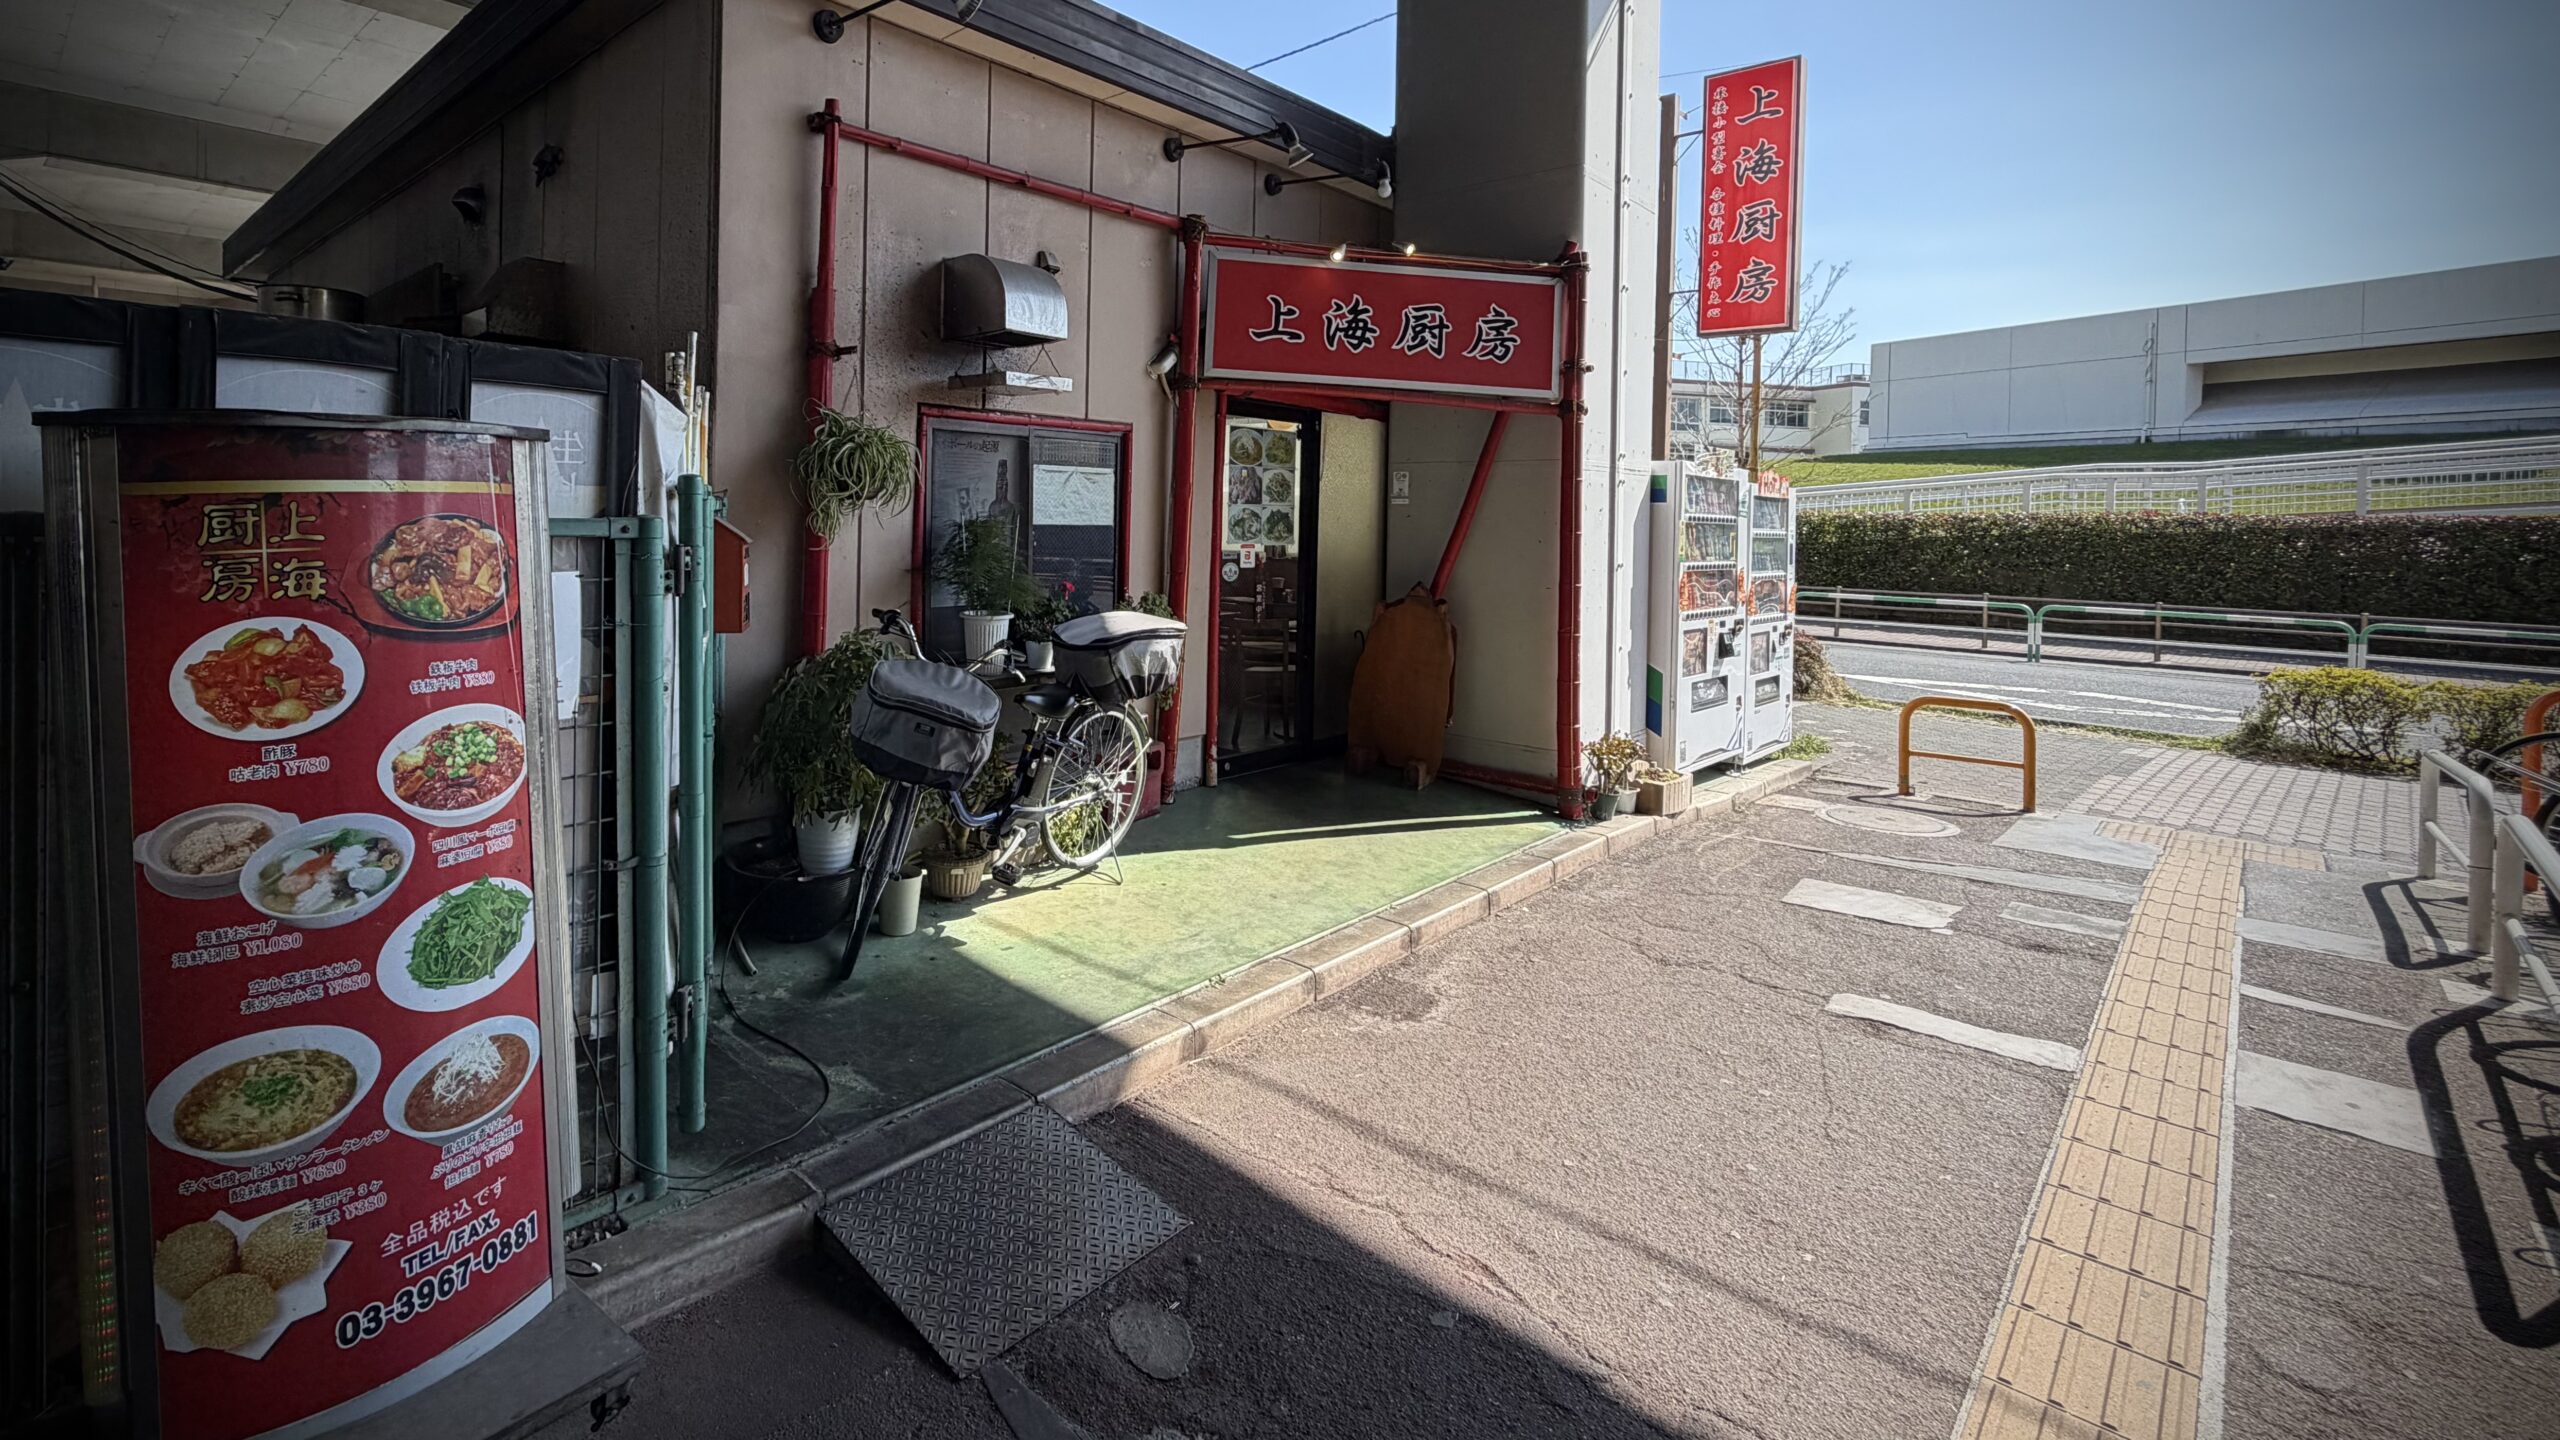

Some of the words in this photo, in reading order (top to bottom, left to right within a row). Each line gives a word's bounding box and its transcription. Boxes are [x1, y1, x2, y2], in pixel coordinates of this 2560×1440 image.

[1727, 85, 1783, 304] 上海厨房
[1249, 293, 1521, 364] 上海厨房
[197, 502, 261, 604] 厨房
[268, 500, 327, 602] 上海
[229, 763, 280, 783] 咕老肉
[283, 756, 330, 776] ¥780
[262, 744, 297, 762] 酢豚
[438, 843, 484, 868] 麻婆豆腐
[196, 919, 277, 946] 海鮮おこげ
[240, 984, 324, 1015] 素炒空心菜
[326, 972, 371, 1001] ¥680
[248, 959, 361, 995] 空心菜塩味炒め
[178, 1129, 390, 1195] 辛くて酸っぱいサンラータンメン
[299, 1158, 345, 1184] ¥680
[292, 1209, 341, 1236] 芝麻球
[343, 1192, 387, 1220] ¥380
[293, 1187, 355, 1217] ごま団子
[380, 1176, 508, 1258] 全品税込です
[336, 1211, 538, 1349] 03-3967-0881
